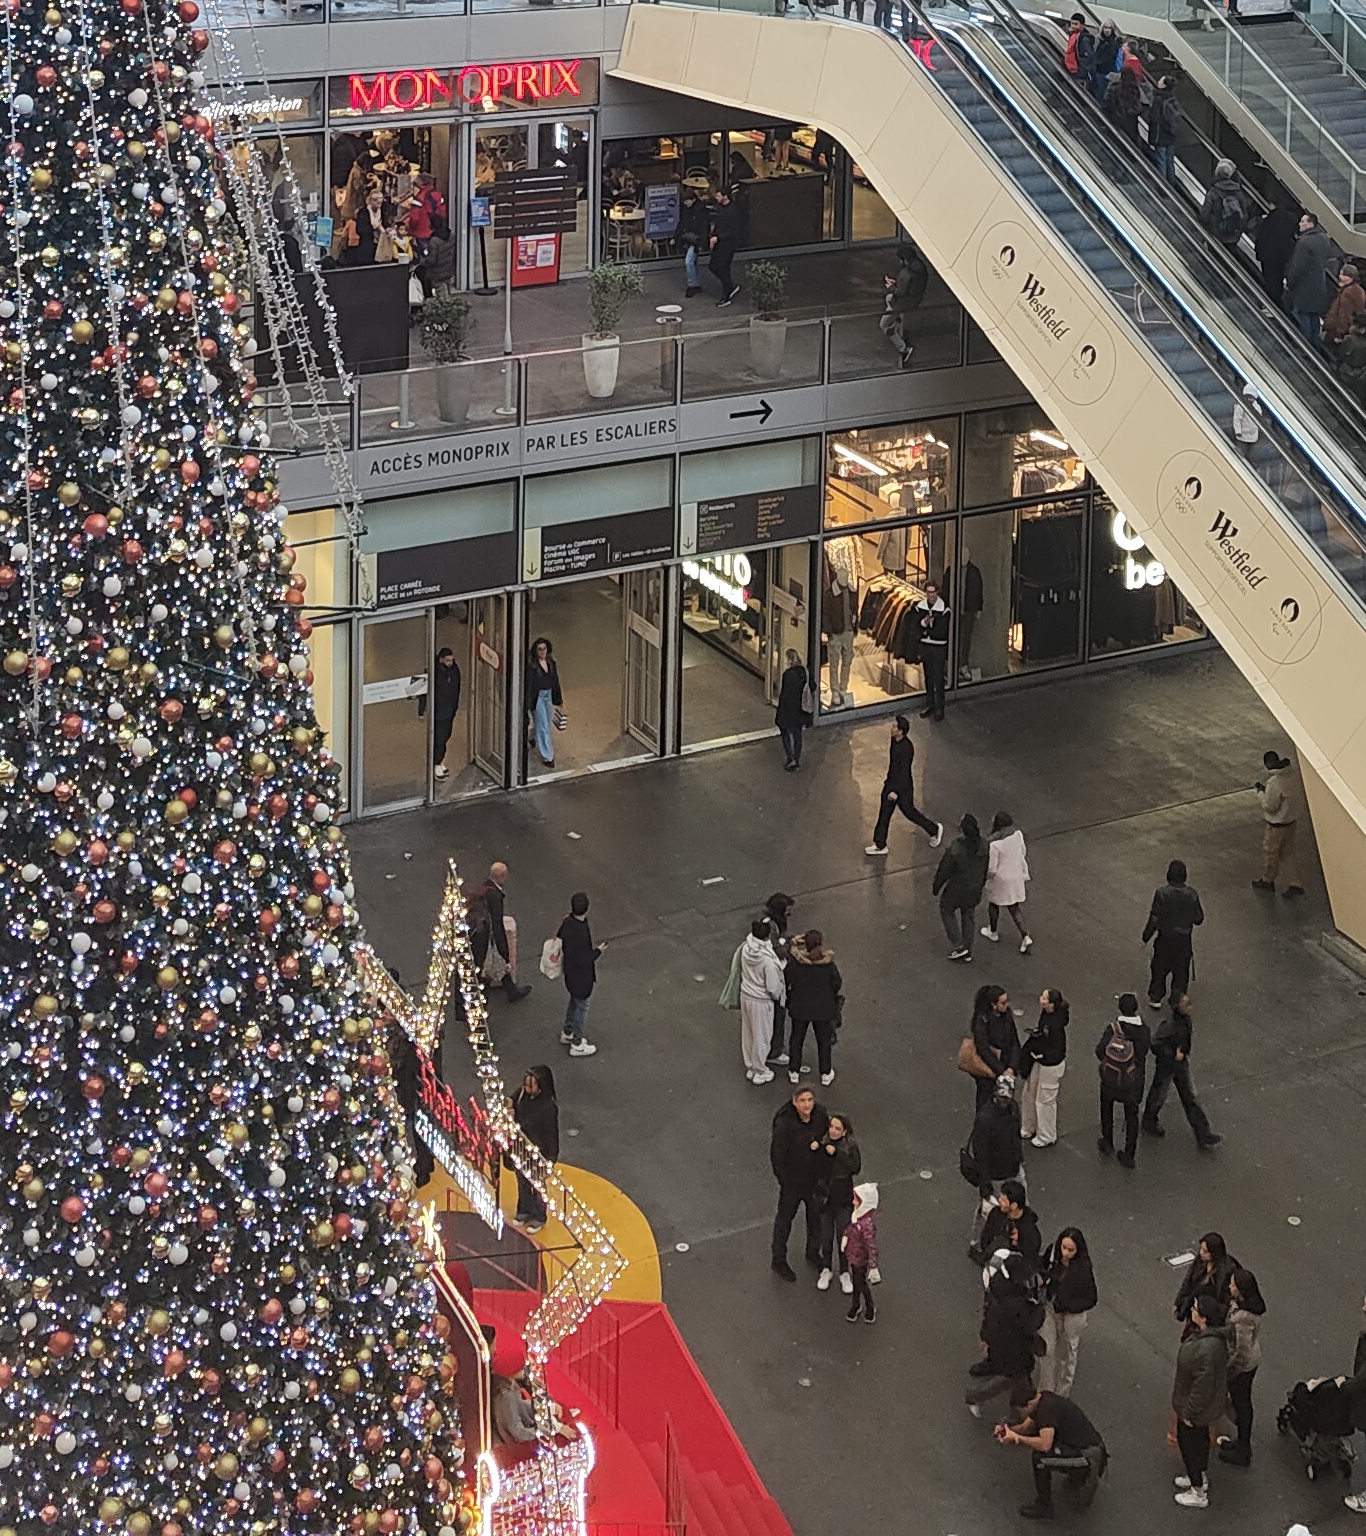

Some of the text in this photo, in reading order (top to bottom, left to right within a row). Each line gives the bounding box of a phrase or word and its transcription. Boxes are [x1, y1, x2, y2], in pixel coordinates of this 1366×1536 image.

[349, 59, 581, 111] MONOPRIX
[1020, 272, 1071, 342] Westfield
[370, 418, 677, 476] ACCÈS MONOPRIX PAR LES ESCALIERS
[574, 537, 606, 547] Commerce
[574, 552, 595, 561] Images
[1208, 508, 1269, 591] Westfield
[380, 584, 398, 593] PLACE
[380, 592, 398, 601] PLACE
